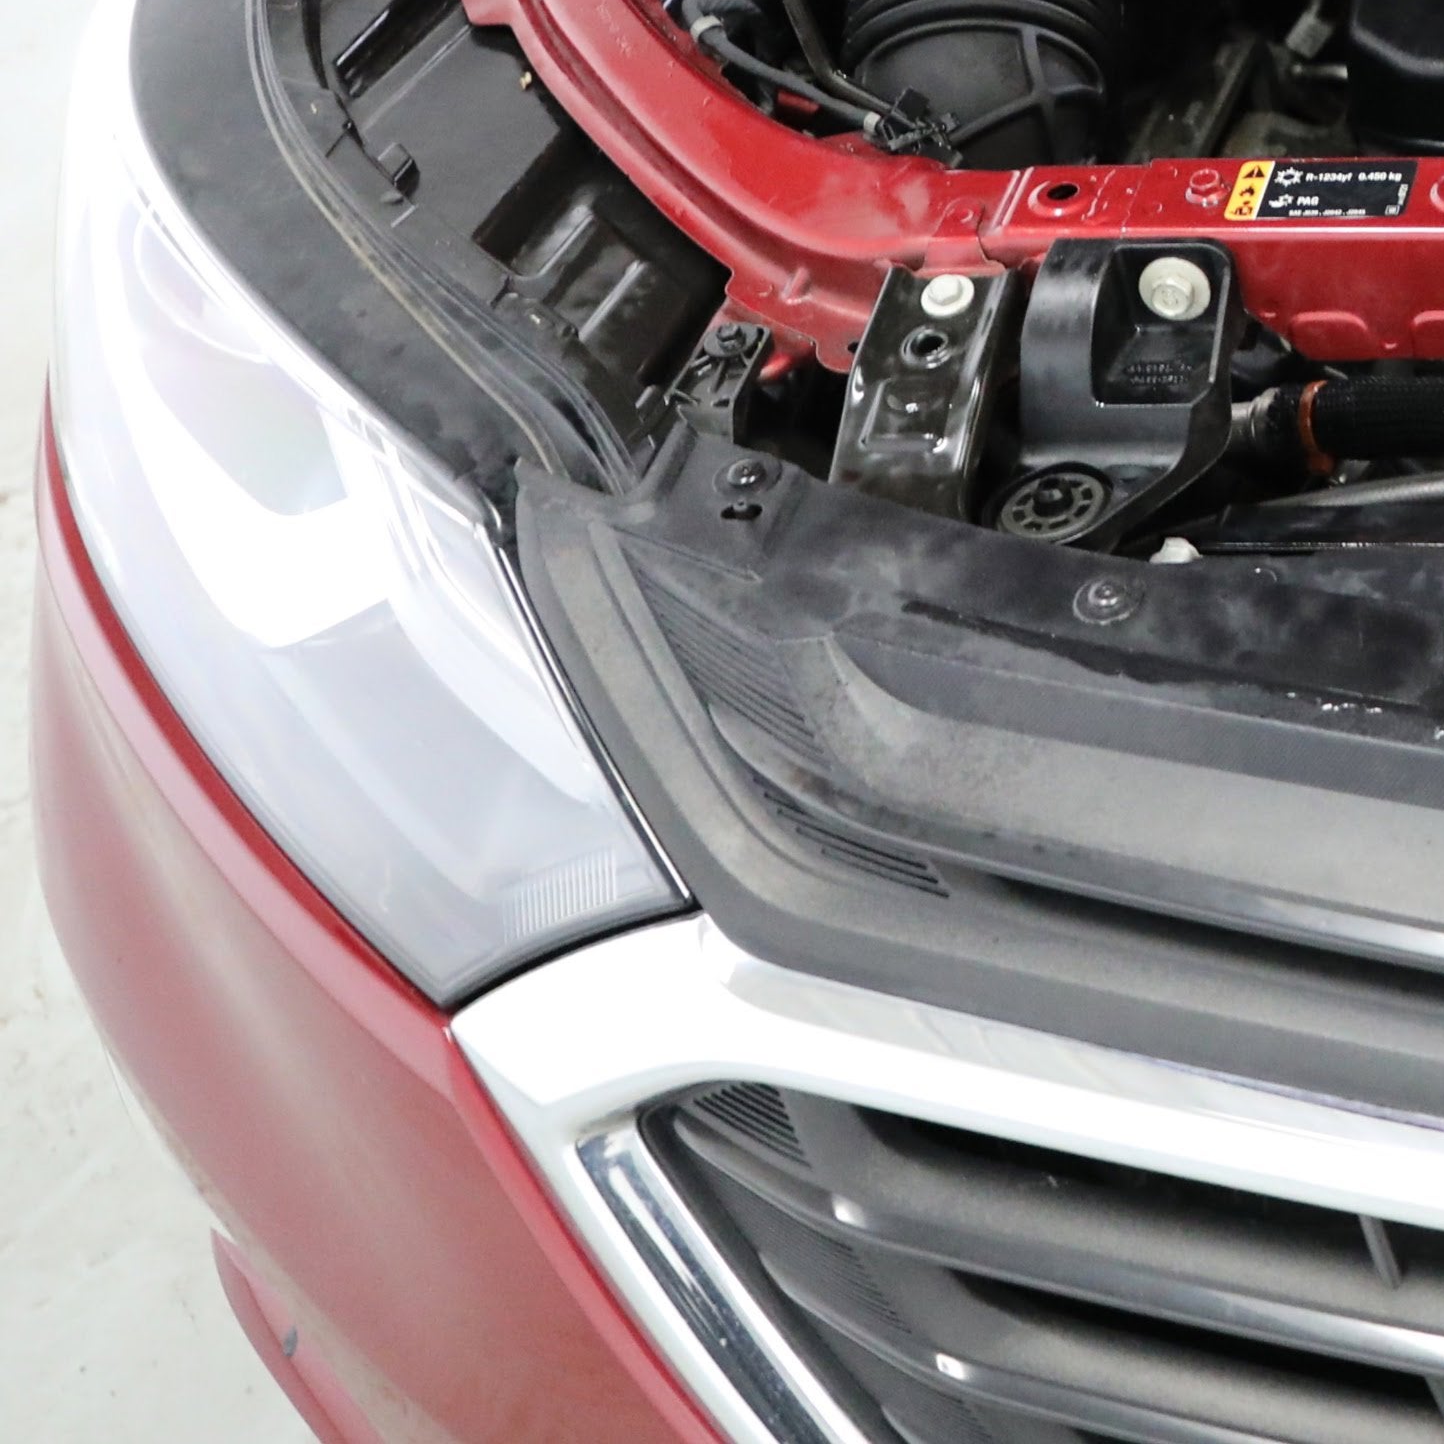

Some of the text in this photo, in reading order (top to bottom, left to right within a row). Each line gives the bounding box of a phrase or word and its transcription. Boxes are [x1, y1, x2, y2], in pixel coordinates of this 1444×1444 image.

[1305, 172, 1353, 183] R-1234yf
[1388, 171, 1402, 183] kg
[1296, 196, 1319, 206] PAG
